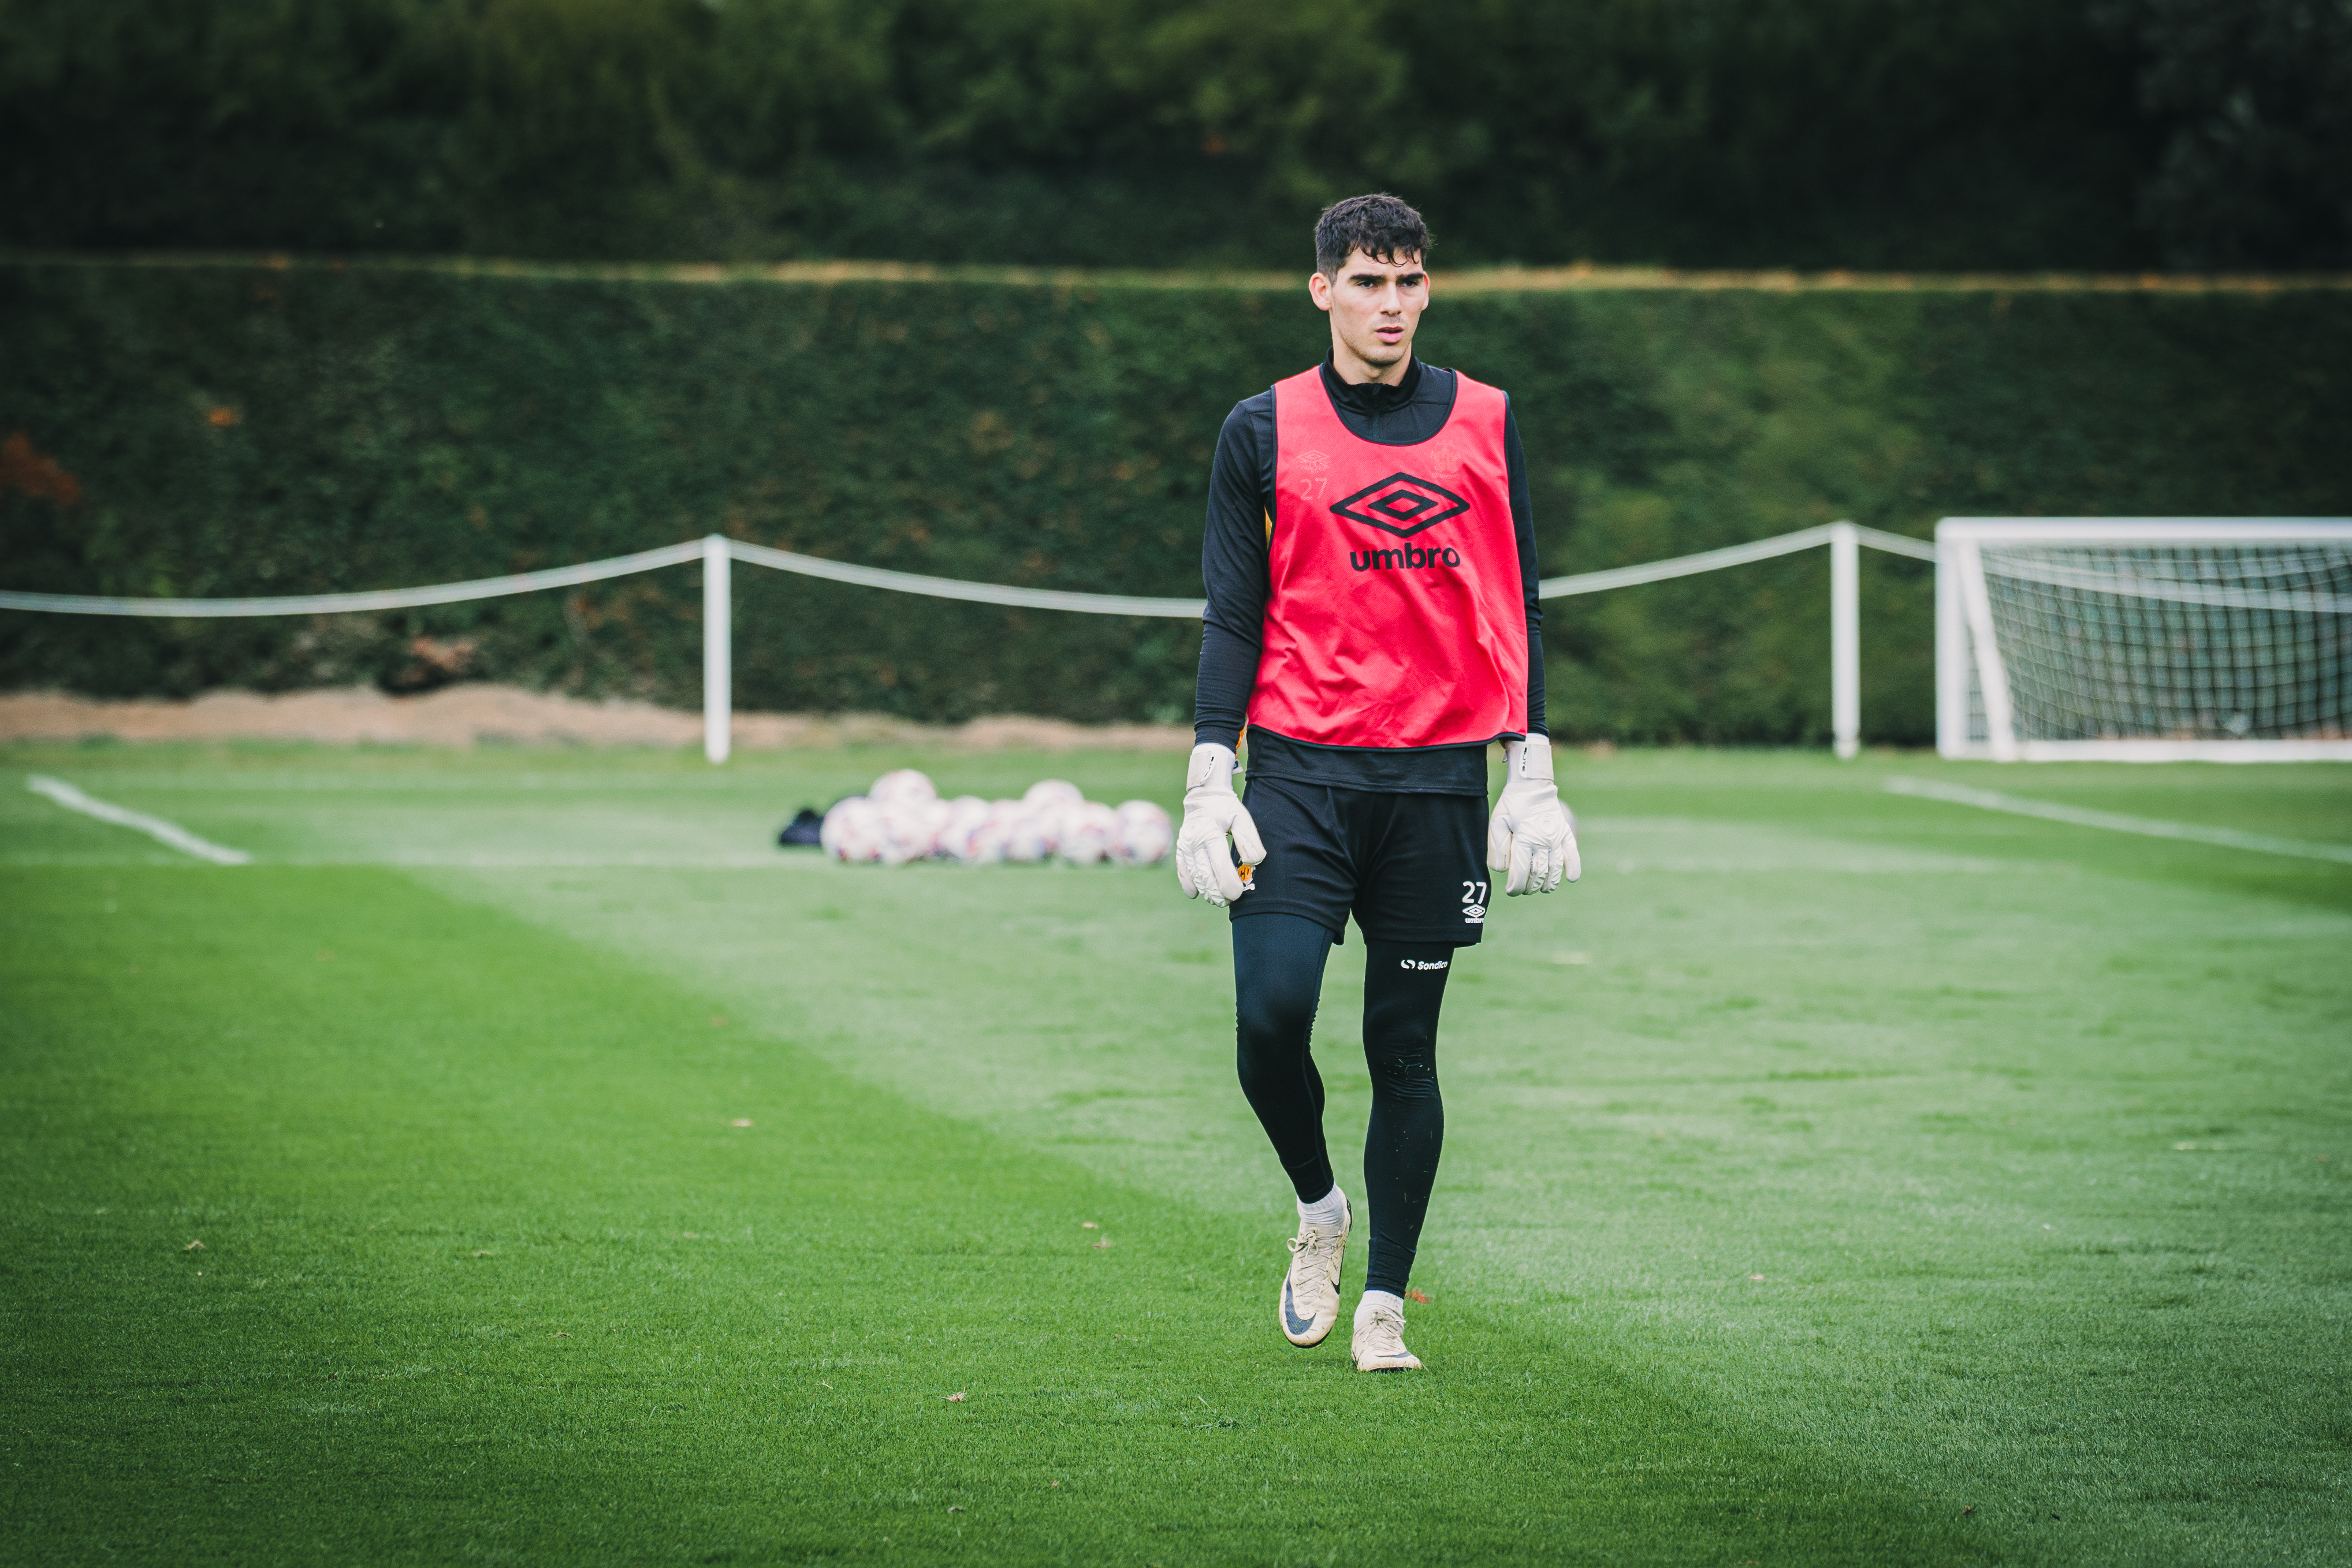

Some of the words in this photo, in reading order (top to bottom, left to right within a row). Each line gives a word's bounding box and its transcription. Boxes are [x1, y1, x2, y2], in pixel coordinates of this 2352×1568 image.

[1300, 478, 1327, 501] 27
[1350, 542, 1460, 571] umbro
[1462, 881, 1487, 904] 27
[1417, 960, 1448, 970] Sondico
